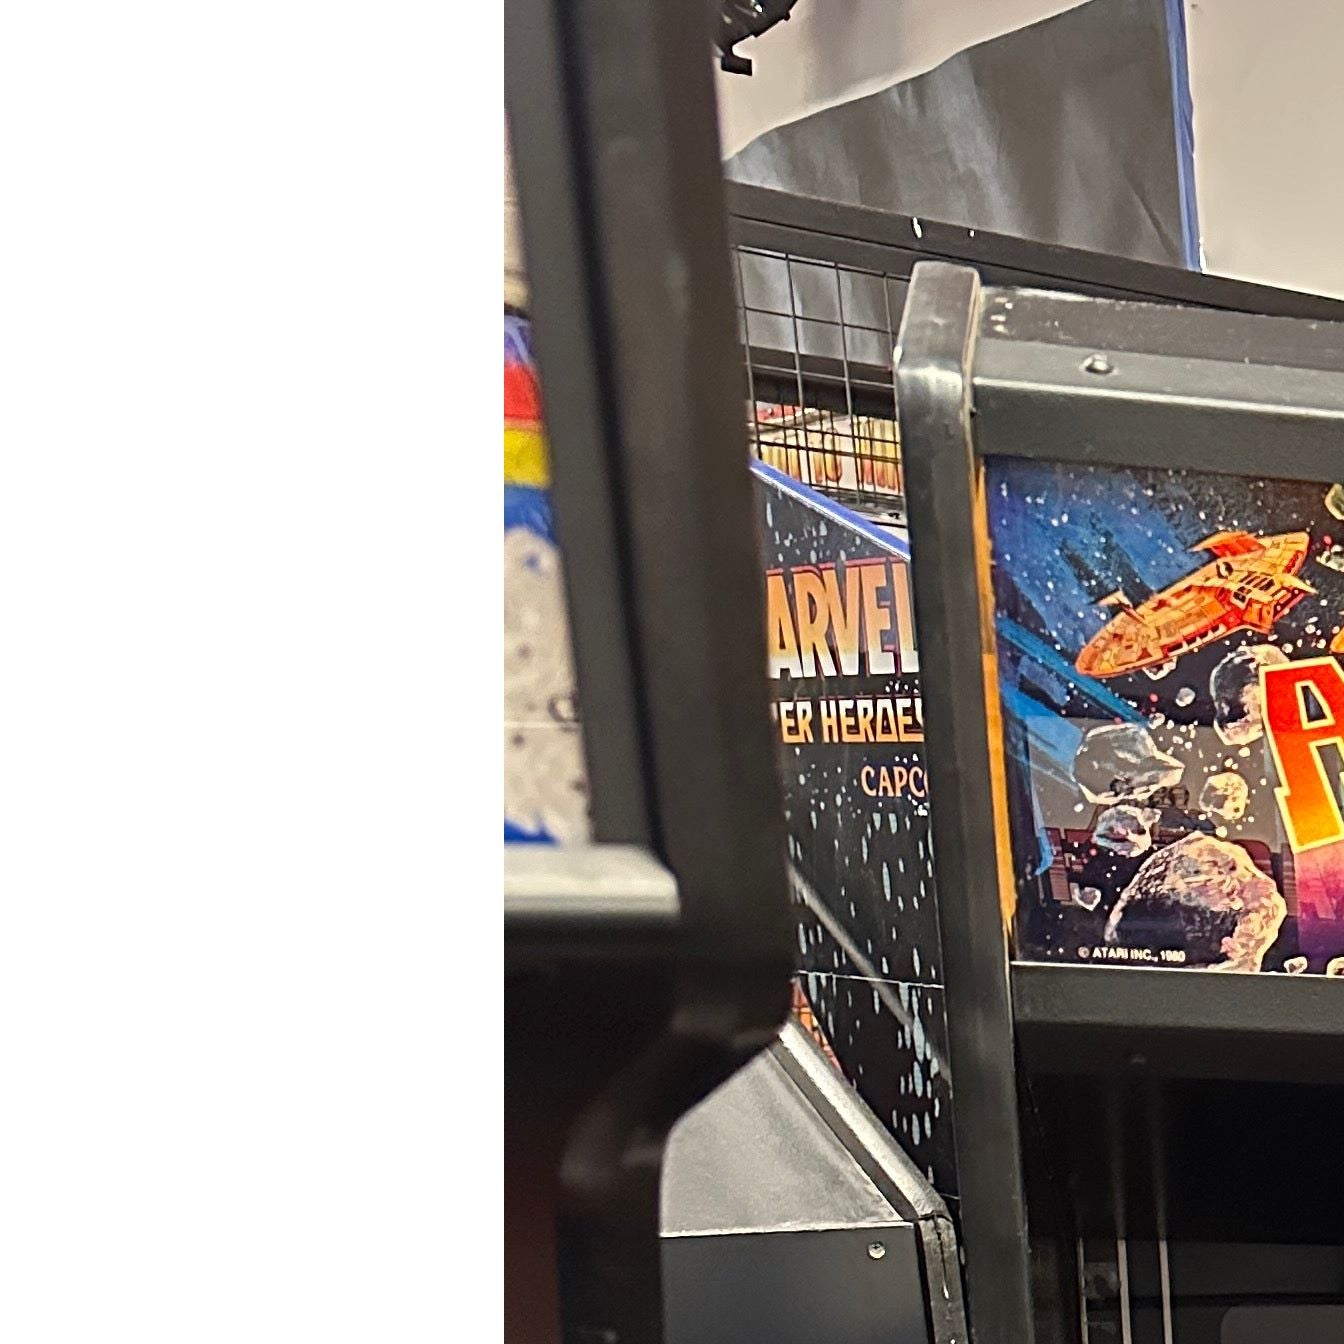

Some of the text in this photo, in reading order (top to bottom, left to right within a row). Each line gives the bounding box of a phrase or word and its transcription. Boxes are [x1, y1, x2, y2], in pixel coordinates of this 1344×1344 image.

[766, 556, 920, 679] ARVEL
[860, 765, 928, 798] CAPC
[1092, 948, 1128, 959] ATARI
